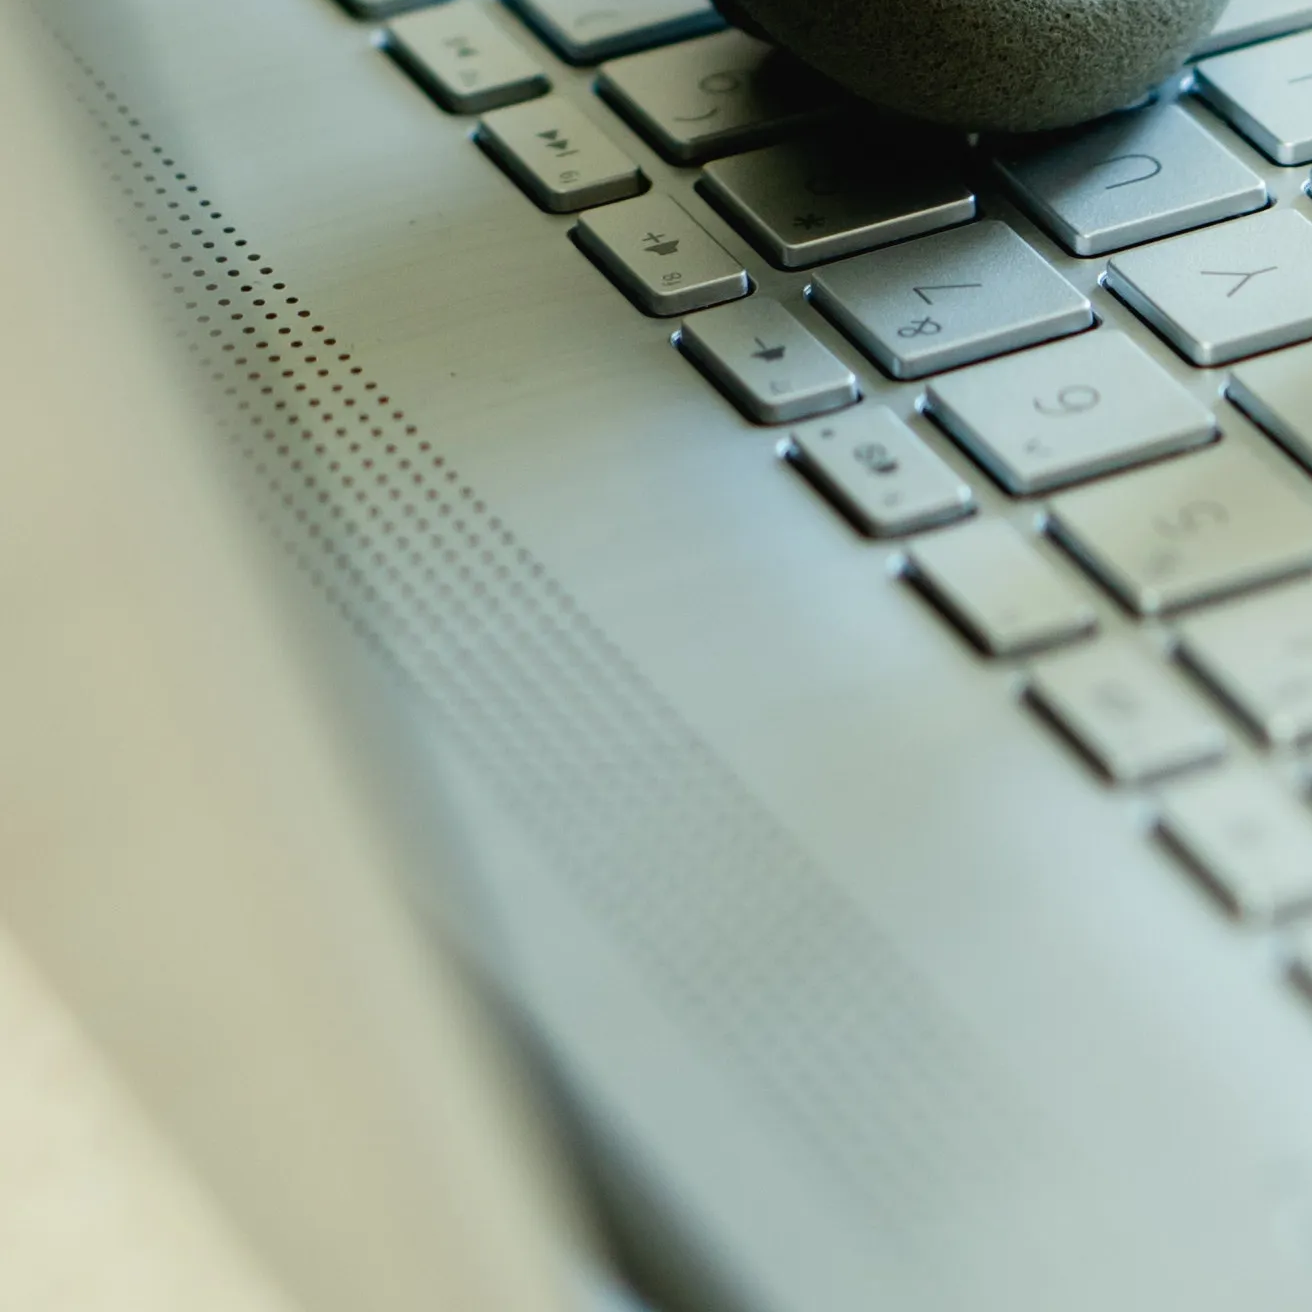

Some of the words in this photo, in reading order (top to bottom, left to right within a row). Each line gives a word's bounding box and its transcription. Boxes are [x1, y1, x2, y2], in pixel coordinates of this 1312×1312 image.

[1094, 153, 1163, 190] U
[911, 281, 983, 306] 7
[1200, 265, 1278, 298] Y
[897, 315, 942, 338] &
[1031, 382, 1103, 420] 6
[1150, 497, 1231, 542] 5
